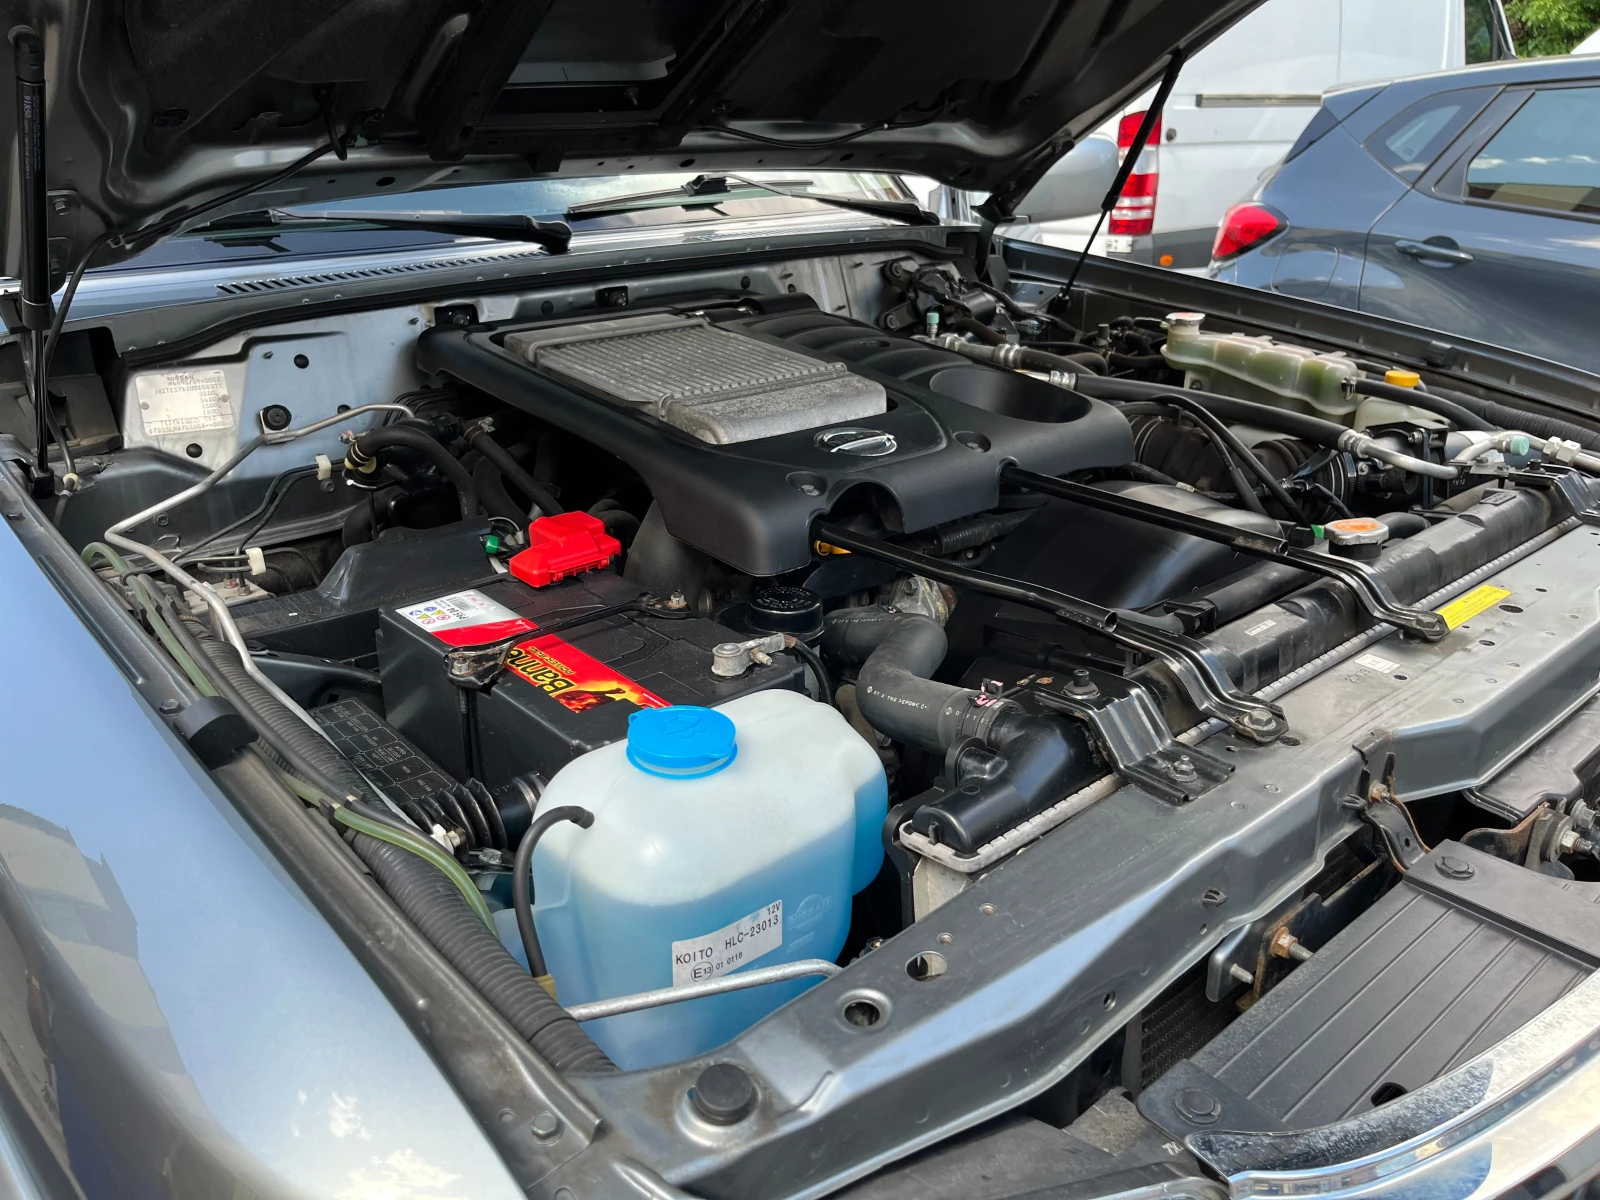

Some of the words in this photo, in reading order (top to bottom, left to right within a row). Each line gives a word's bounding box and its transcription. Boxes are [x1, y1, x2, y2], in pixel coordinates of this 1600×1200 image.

[166, 374, 195, 382] NISSAN
[507, 648, 577, 694] Banne
[767, 902, 781, 916] 12V
[675, 947, 714, 965] KOITO
[725, 914, 779, 950] HLC-23013
[716, 962, 724, 970] 01
[727, 951, 743, 966] 0118
